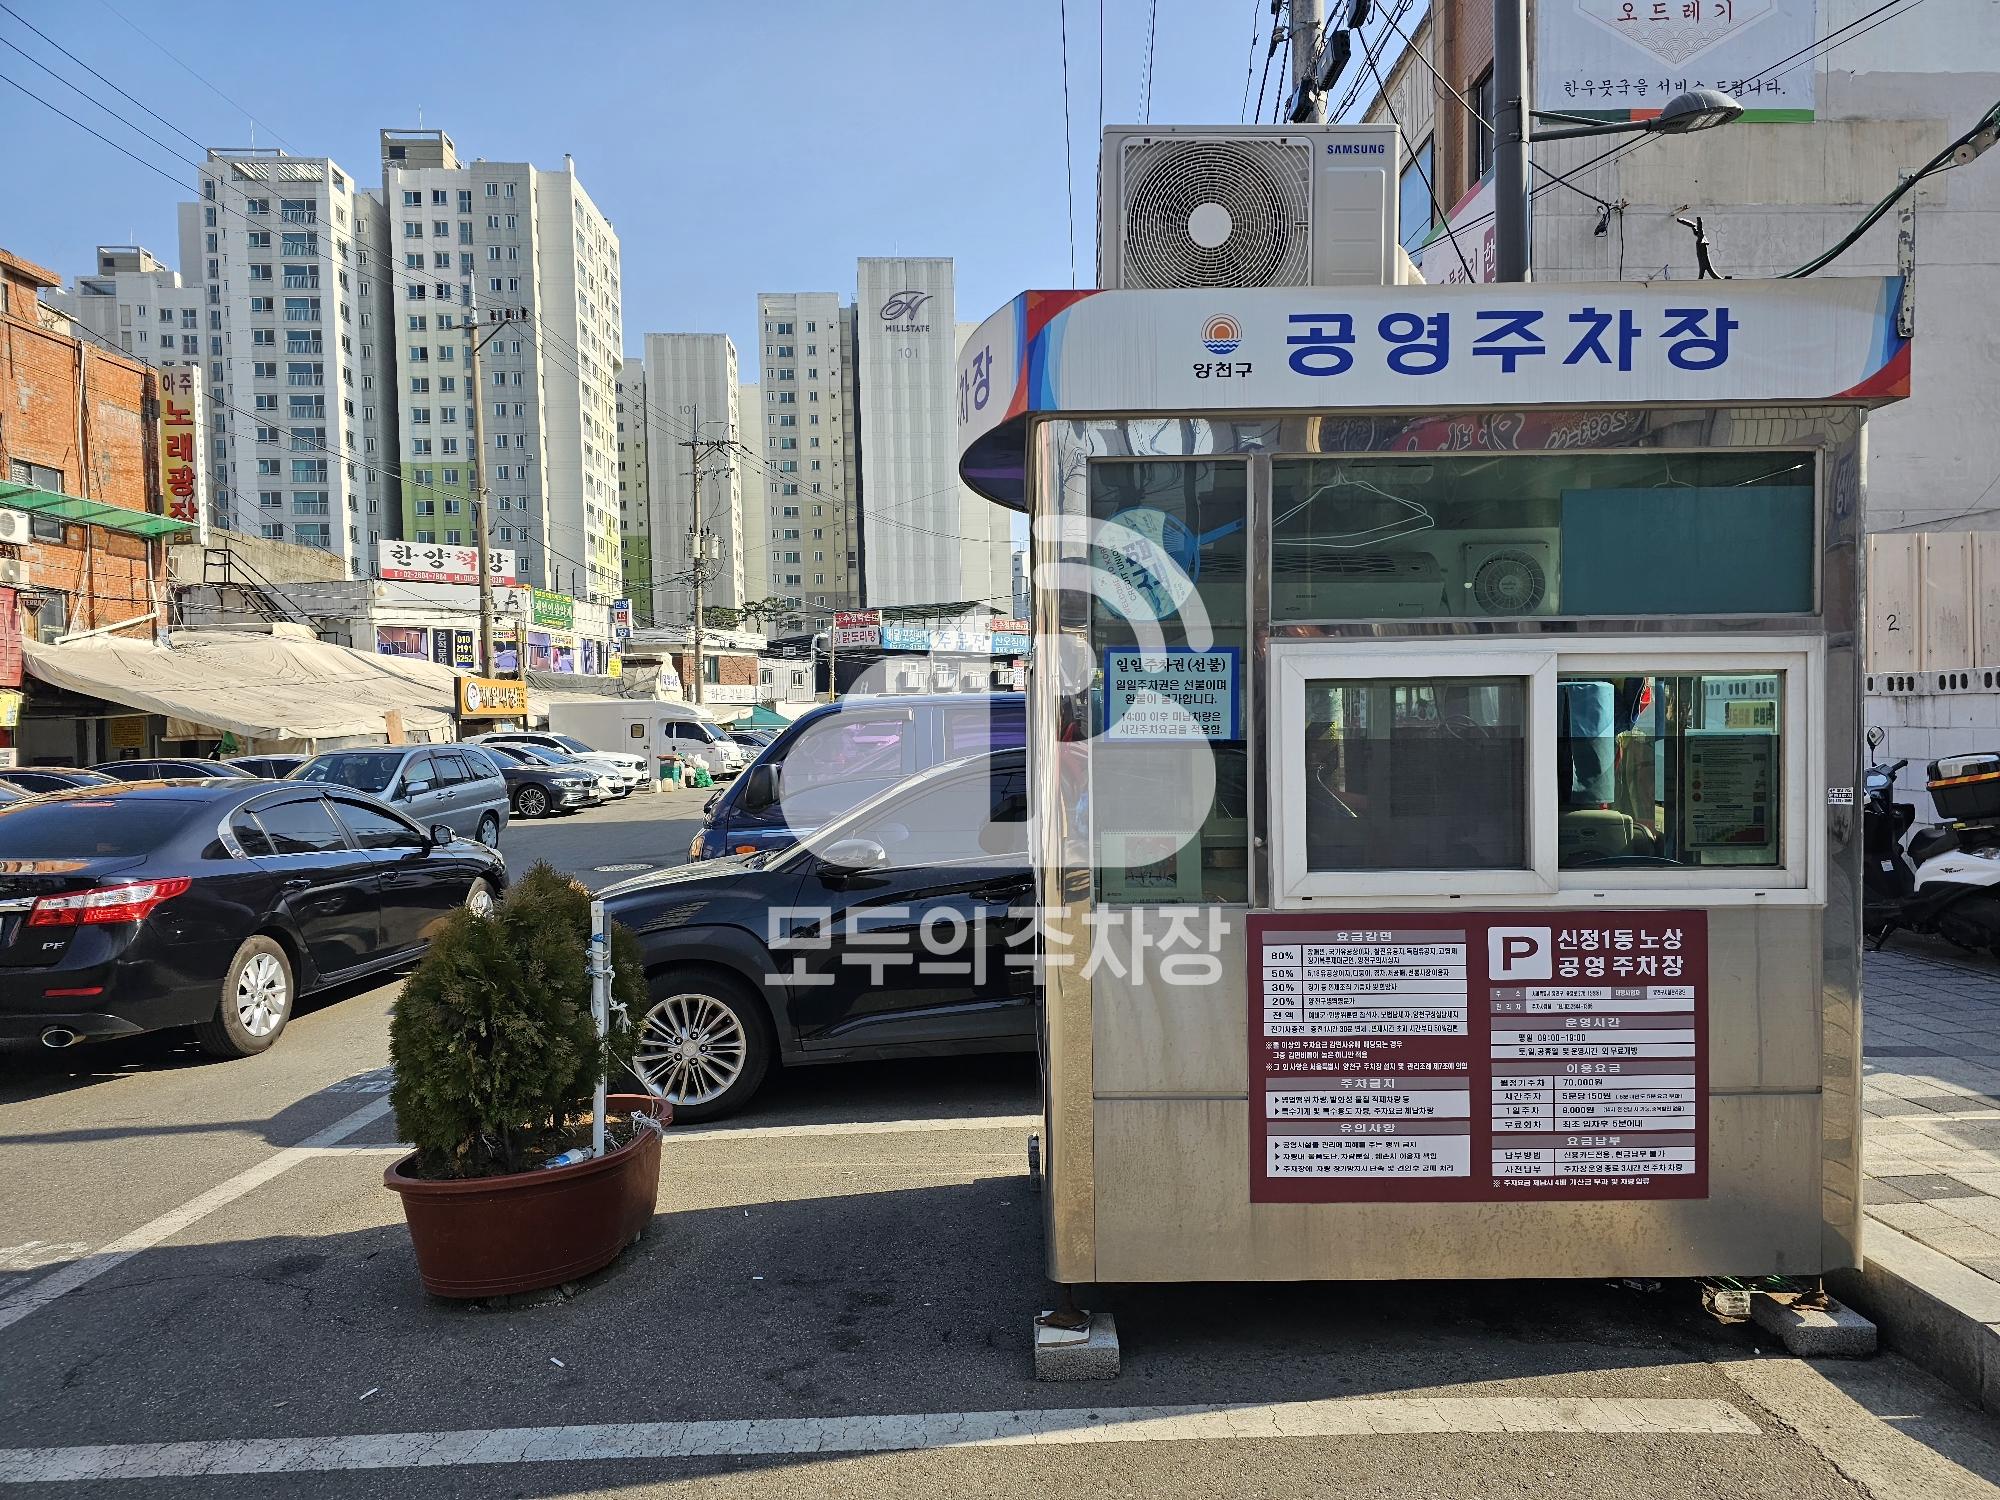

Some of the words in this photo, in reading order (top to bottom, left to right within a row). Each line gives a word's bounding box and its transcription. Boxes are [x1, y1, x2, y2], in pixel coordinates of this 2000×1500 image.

[1326, 143, 1385, 155] SAMSUNG
[885, 324, 930, 333] HILLSTATE
[1286, 307, 1739, 376] 공영주차장
[897, 348, 919, 359] 101
[1192, 362, 1253, 379] 양천구
[162, 373, 193, 395] 아주
[1111, 544, 1125, 570] UNION
[1121, 572, 1136, 601] CREDIT
[1886, 614, 1900, 631] 2
[457, 635, 471, 644] 010
[842, 631, 876, 644] 닭도리탕
[1116, 679, 1180, 691] 일일주차권은
[1183, 679, 1227, 691] 선불이며
[1125, 693, 1157, 705] 환불이
[1161, 693, 1217, 705] 불가합니다.
[1122, 711, 1146, 722] 14:00
[1149, 711, 1169, 722] 이후
[1172, 711, 1221, 722] 미납차량은
[1120, 724, 1187, 735] 시간주차요금을
[1191, 724, 1223, 735] 적용함.
[1336, 931, 1392, 942] 요금감면
[1557, 928, 1634, 951] 신정1동
[1639, 928, 1683, 950] 노상
[1271, 952, 1294, 960] 80%
[1502, 936, 1539, 971] P
[1271, 969, 1294, 978] 50%
[1271, 983, 1294, 992] 30%
[1272, 997, 1295, 1006] 20%
[1565, 1018, 1621, 1028] 운영시간
[1518, 1033, 1533, 1042] 평일
[1302, 1041, 1328, 1049] 주차요금
[1571, 1047, 1598, 1056] 운영시간
[1601, 1047, 1609, 1056] 외
[1610, 1047, 1638, 1056] 무료개방
[1342, 1063, 1362, 1071] 양천구
[1363, 1063, 1382, 1071] 주차장
[1566, 1063, 1621, 1073] 이용요금
[1340, 1079, 1395, 1089] 주차금지
[1500, 1079, 1545, 1087] 월정기주차
[1504, 1092, 1542, 1100] 시간주차
[1588, 1092, 1611, 1100] 150원
[1505, 1106, 1540, 1114] 1일주차
[1340, 1123, 1395, 1133] 유의사항
[1504, 1121, 1542, 1129] 무료회차
[1582, 1120, 1609, 1128] 입차후
[1612, 1120, 1643, 1128] 5분이내
[1566, 1136, 1621, 1146] 요금납부
[1504, 1151, 1541, 1160] 납부방법
[1615, 1150, 1647, 1159] 현금납부
[1504, 1165, 1541, 1173] 사전납부
[1604, 1164, 1620, 1173] 종료
[1621, 1164, 1641, 1173] 3시간
[1642, 1164, 1650, 1173] 전
[1667, 1164, 1683, 1173] 차량
